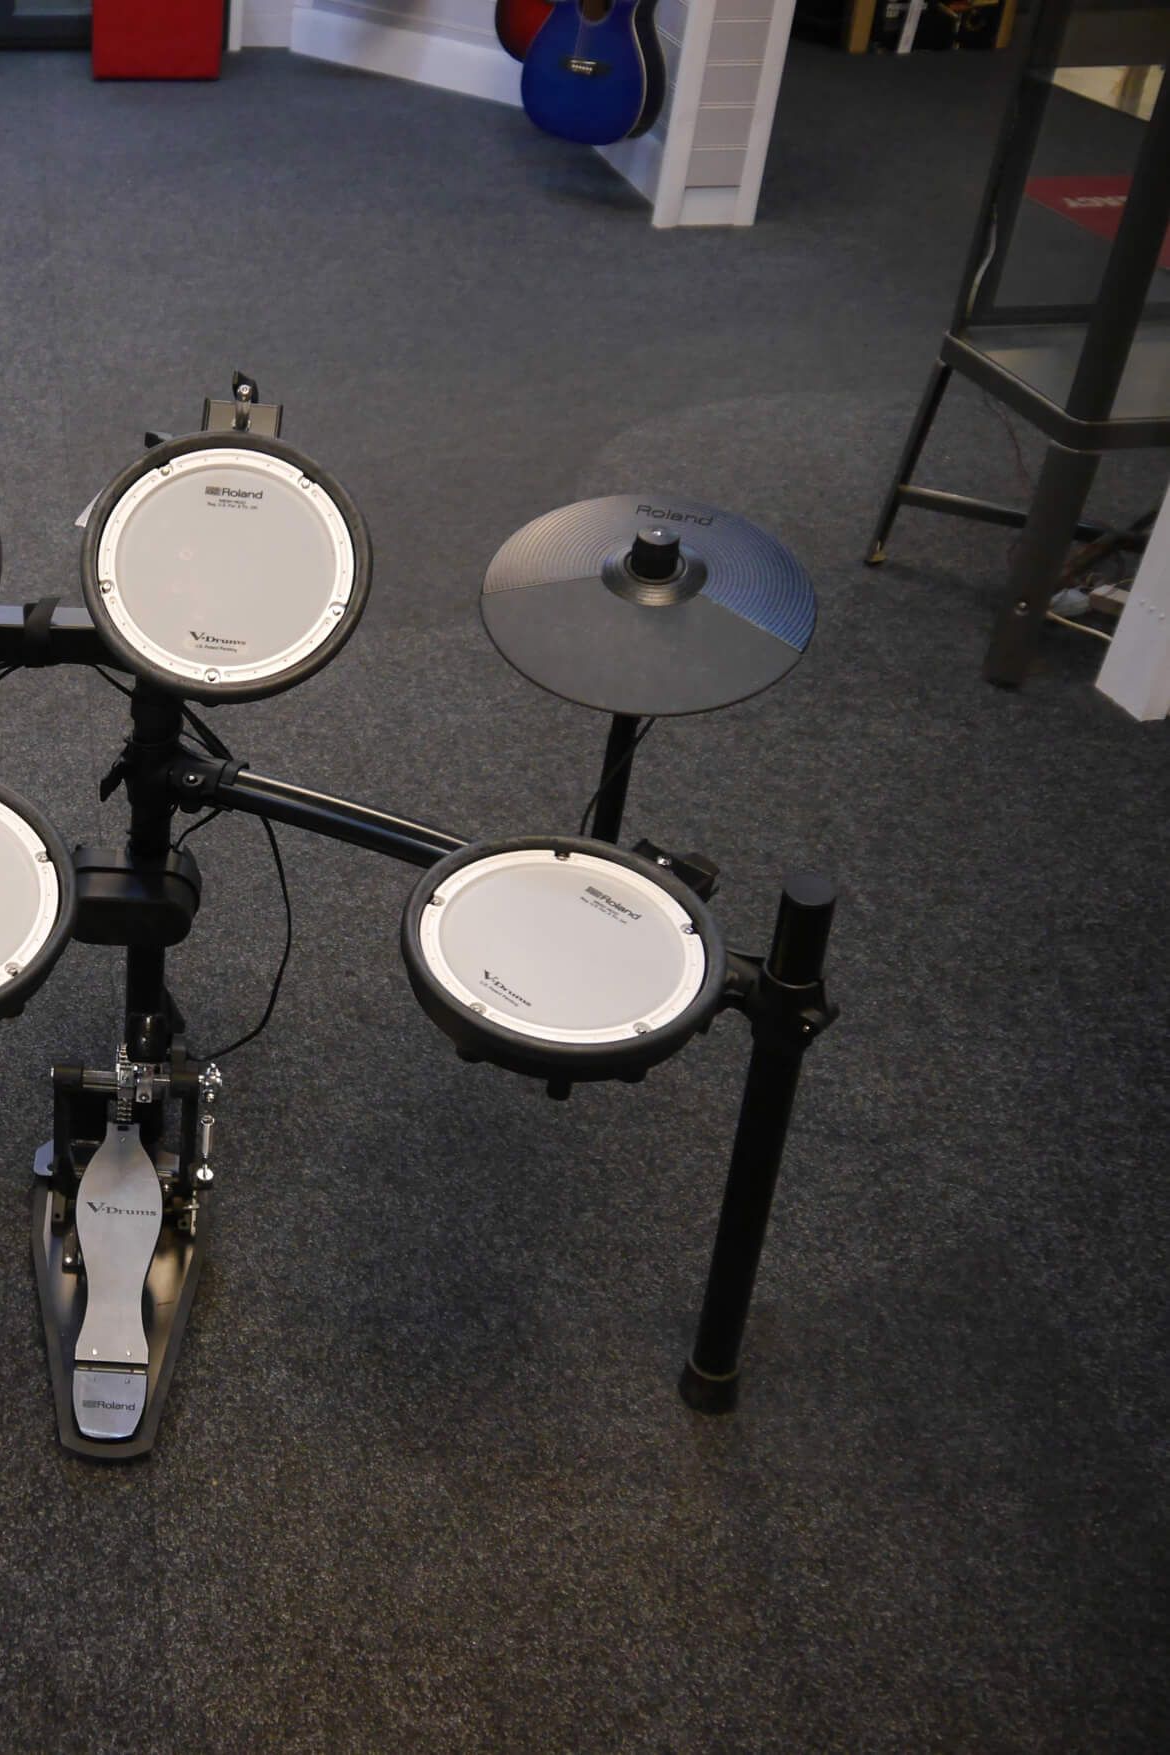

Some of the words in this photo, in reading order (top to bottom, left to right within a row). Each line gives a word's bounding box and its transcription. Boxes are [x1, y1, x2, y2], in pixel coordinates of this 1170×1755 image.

[221, 487, 264, 500] Roland
[636, 504, 714, 526] Roland
[188, 630, 247, 646] V-Drums
[599, 895, 642, 920] Roland
[484, 969, 532, 1007] V-Drums
[86, 1201, 158, 1217] V-Drums
[97, 1400, 136, 1412] Roland
